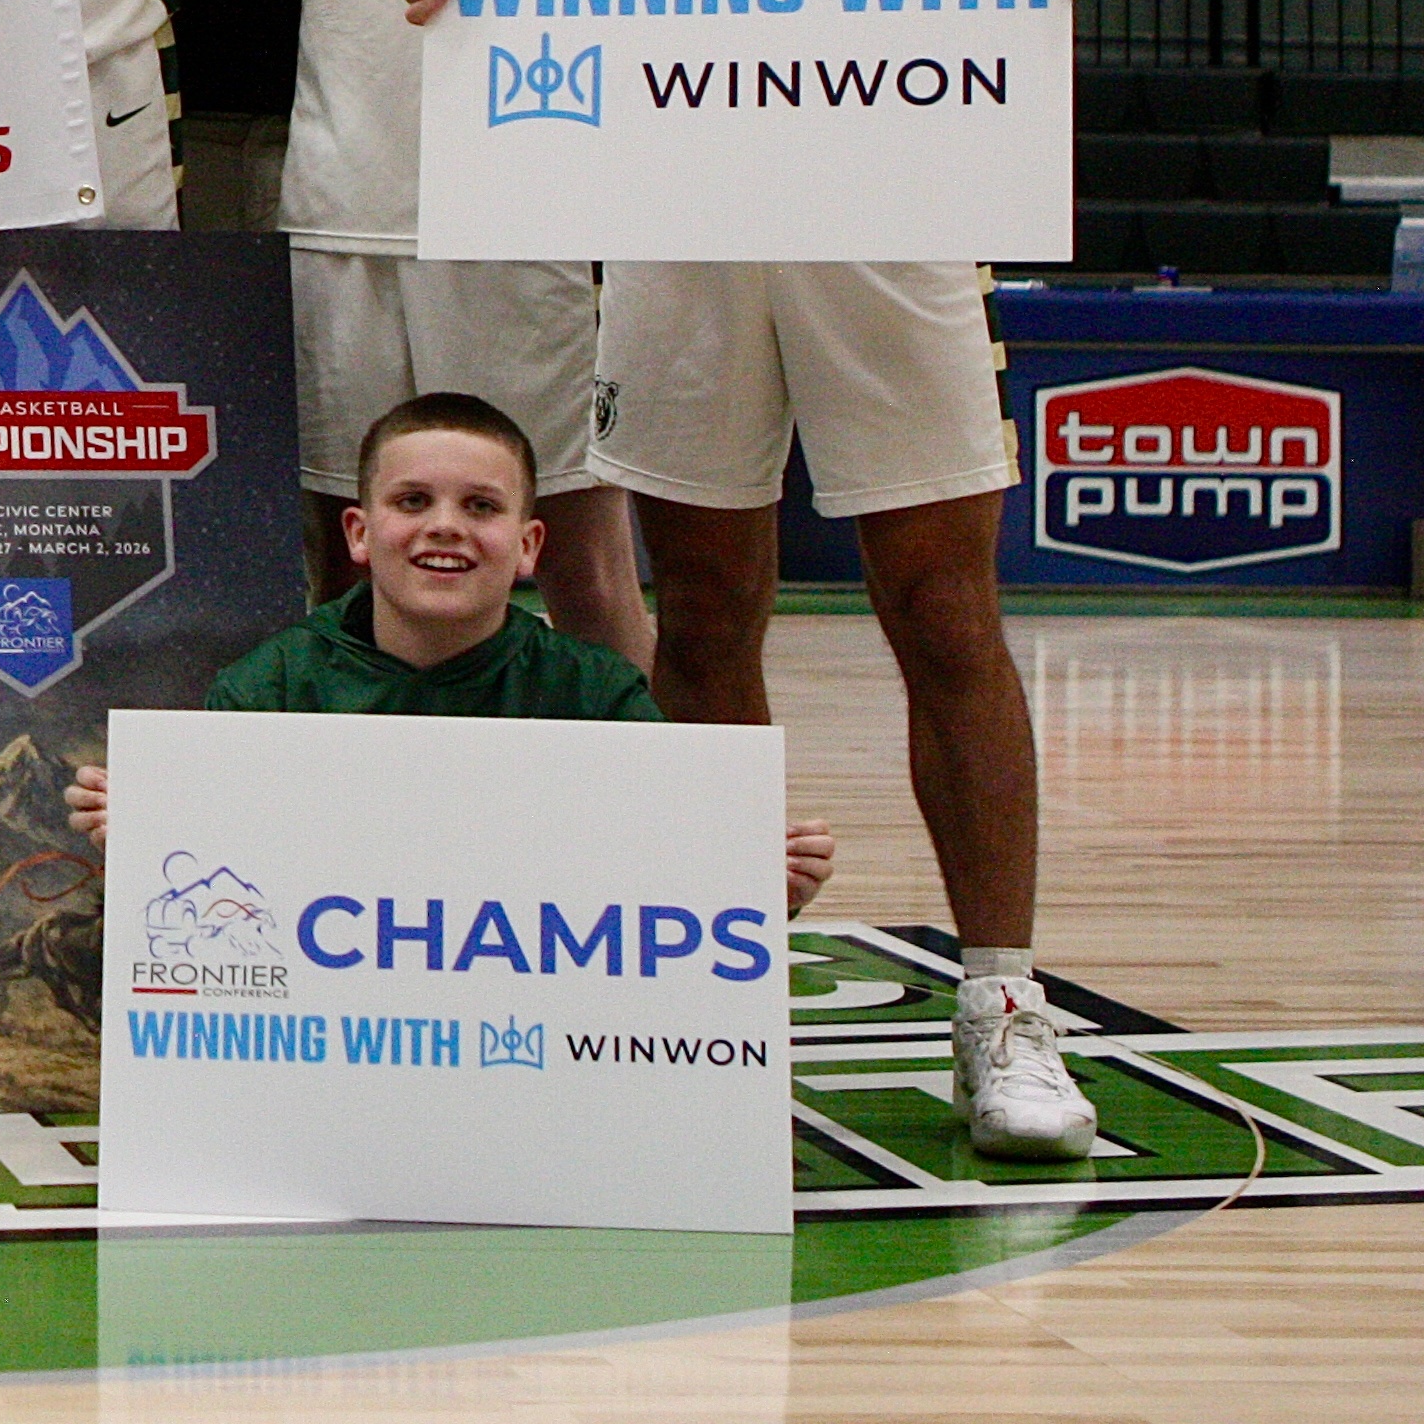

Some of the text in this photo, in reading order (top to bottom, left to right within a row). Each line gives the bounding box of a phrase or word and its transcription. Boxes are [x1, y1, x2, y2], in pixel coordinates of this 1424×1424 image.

[643, 58, 1007, 108] WINWON
[1058, 411, 1319, 465] town
[45, 505, 113, 518] CENTER
[1065, 477, 1319, 528] pump
[14, 525, 100, 537] MONTANA
[29, 543, 90, 555] MARCH
[96, 543, 109, 557] 2,
[114, 543, 151, 556] 2026
[296, 895, 771, 982] CHAMPS
[133, 963, 289, 988] FRONTIER
[203, 987, 289, 999] CONFERENCE
[128, 1010, 767, 1068] WINNING WITH WINWON
